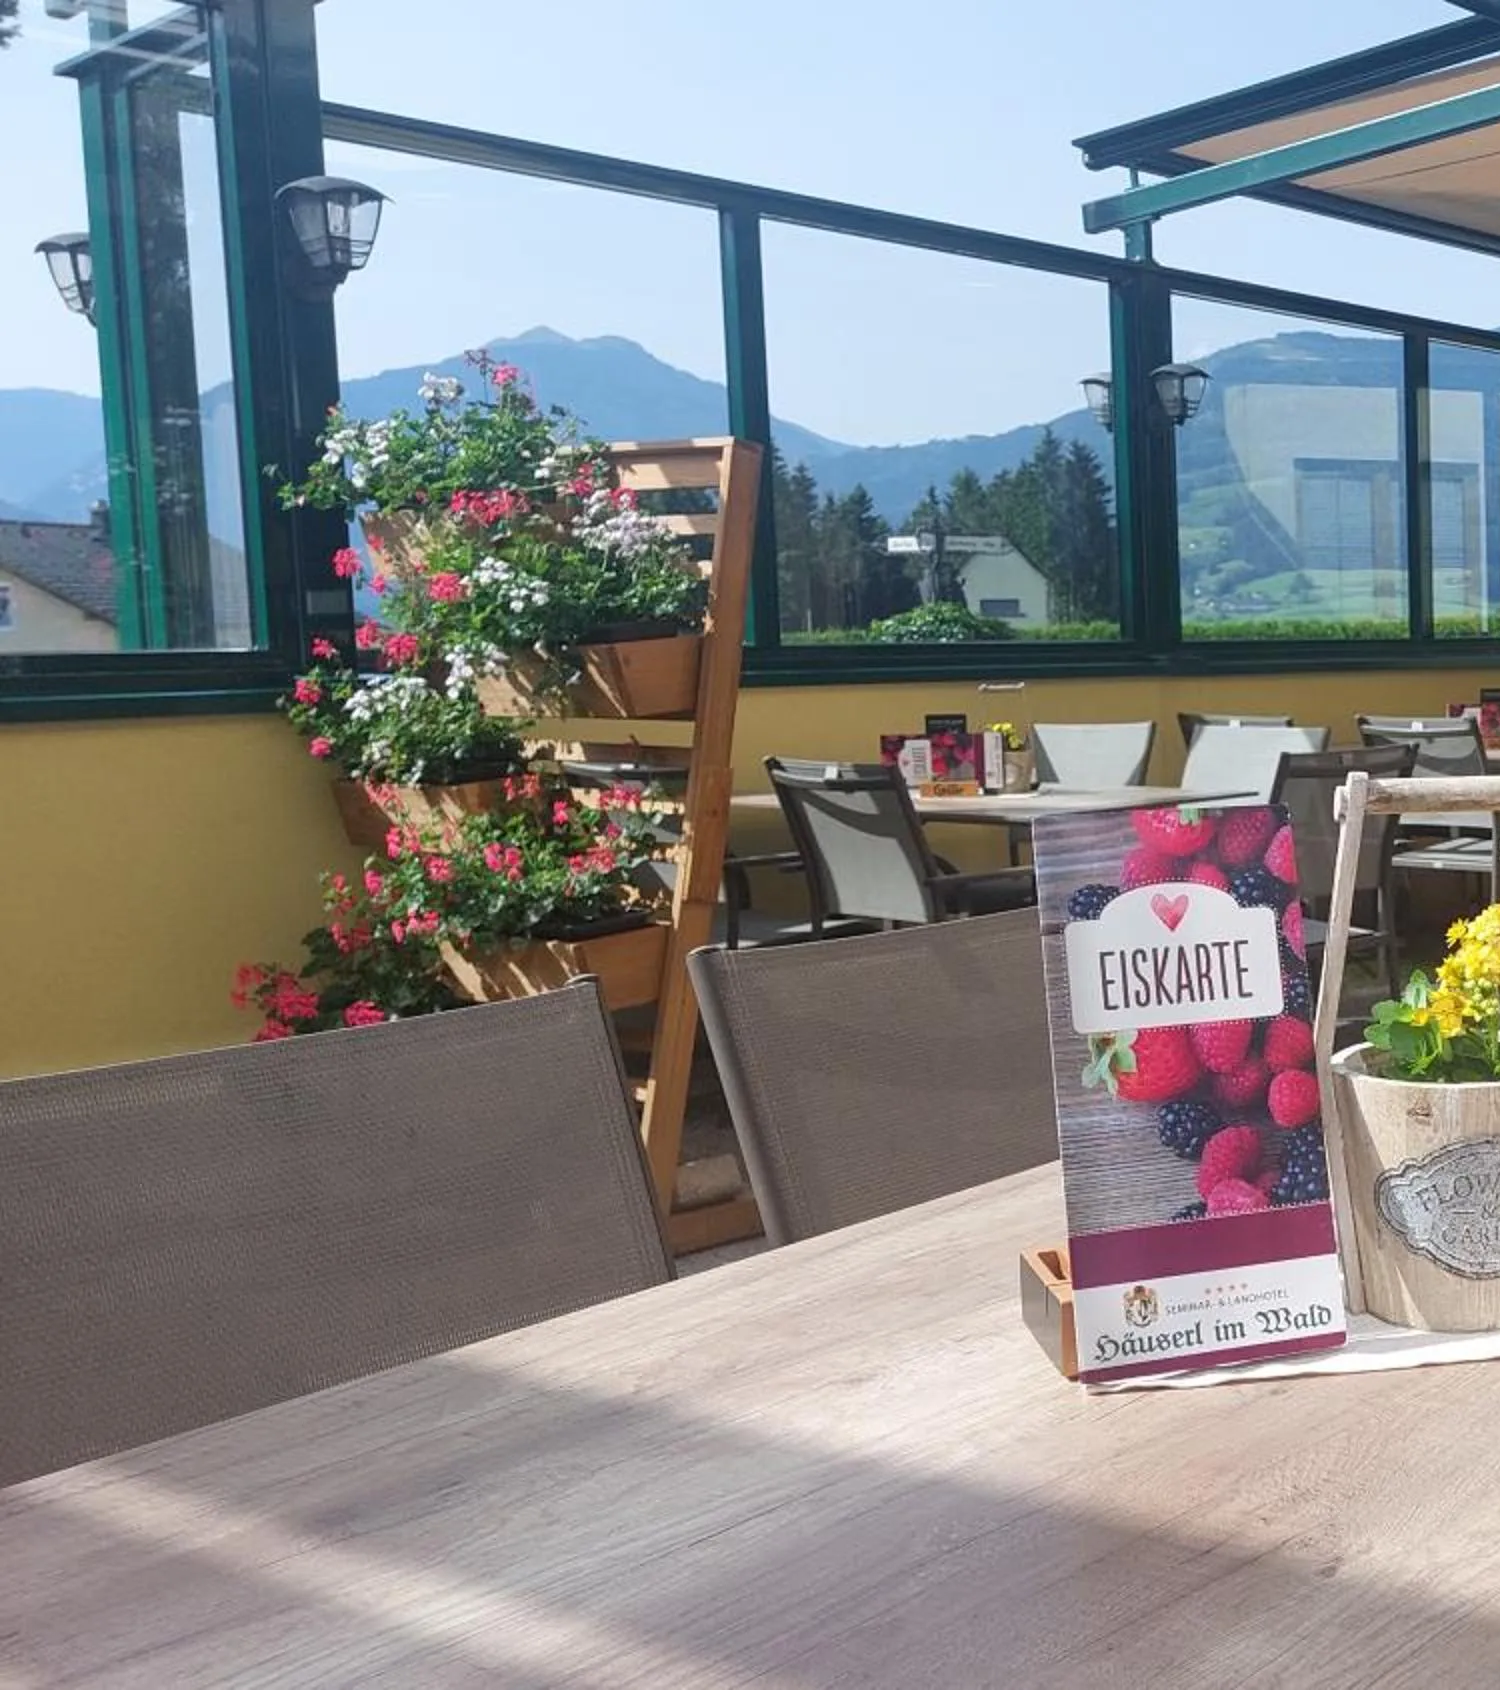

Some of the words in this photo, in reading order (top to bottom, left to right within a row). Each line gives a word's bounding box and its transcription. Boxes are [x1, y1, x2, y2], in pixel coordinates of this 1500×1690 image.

[1099, 939, 1254, 1011] EISKARTE
[1480, 1202, 1498, 1220] &
[1094, 1320, 1204, 1362] Häuserl
[1214, 1318, 1247, 1342] im
[1254, 1303, 1333, 1334] Wald
